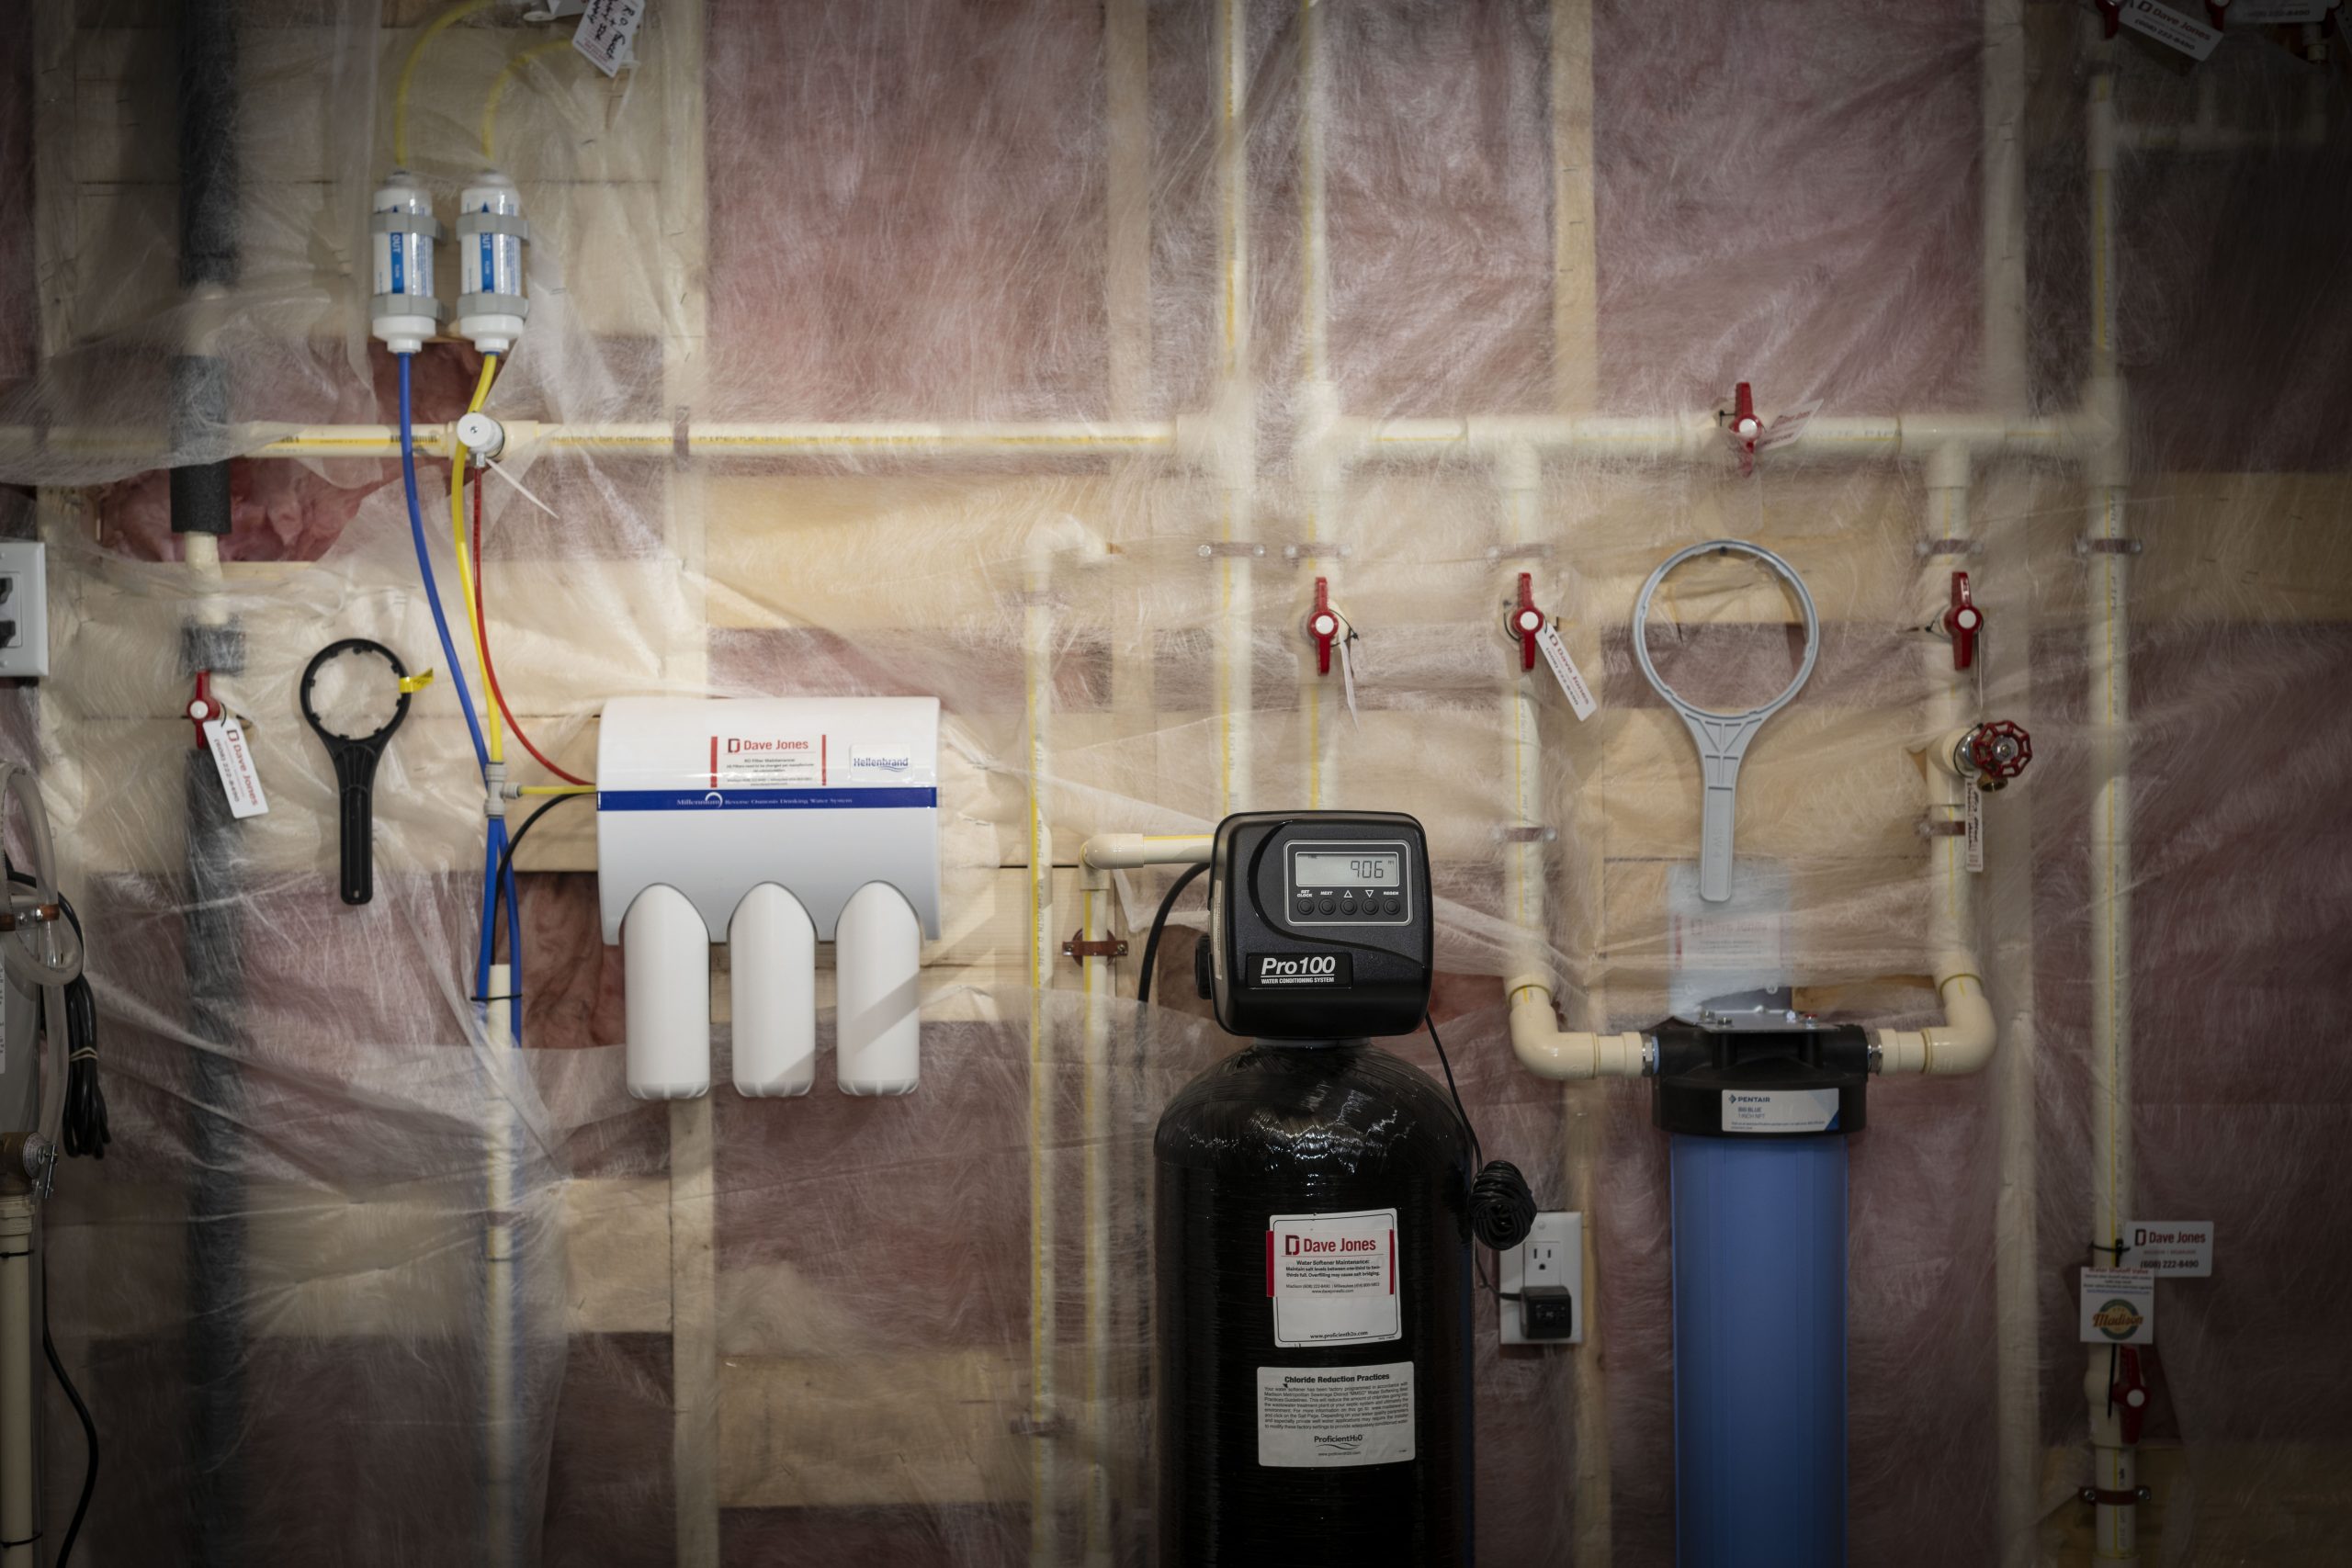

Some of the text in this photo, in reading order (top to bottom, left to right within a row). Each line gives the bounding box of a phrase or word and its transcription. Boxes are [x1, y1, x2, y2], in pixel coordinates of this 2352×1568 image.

[2153, 8, 2179, 25] Dave
[2180, 22, 2211, 40] Jones
[392, 234, 400, 253] OUT
[1558, 648, 1589, 705] Dave Jones
[744, 739, 809, 750] Dave Jones
[854, 756, 909, 770] Hellenbrand
[234, 744, 258, 806] Dave Jones
[677, 798, 721, 807] Millennium
[1261, 956, 1336, 976] Pro100
[2149, 1231, 2206, 1243] Dave Jones
[1304, 1238, 1376, 1252] Dave Jones
[2163, 1260, 2199, 1269] 222-8490
[2092, 1312, 2143, 1327] Madison
[1310, 1331, 1368, 1339] www.proficienth2o.com
[1317, 1375, 1355, 1383] Reduction
